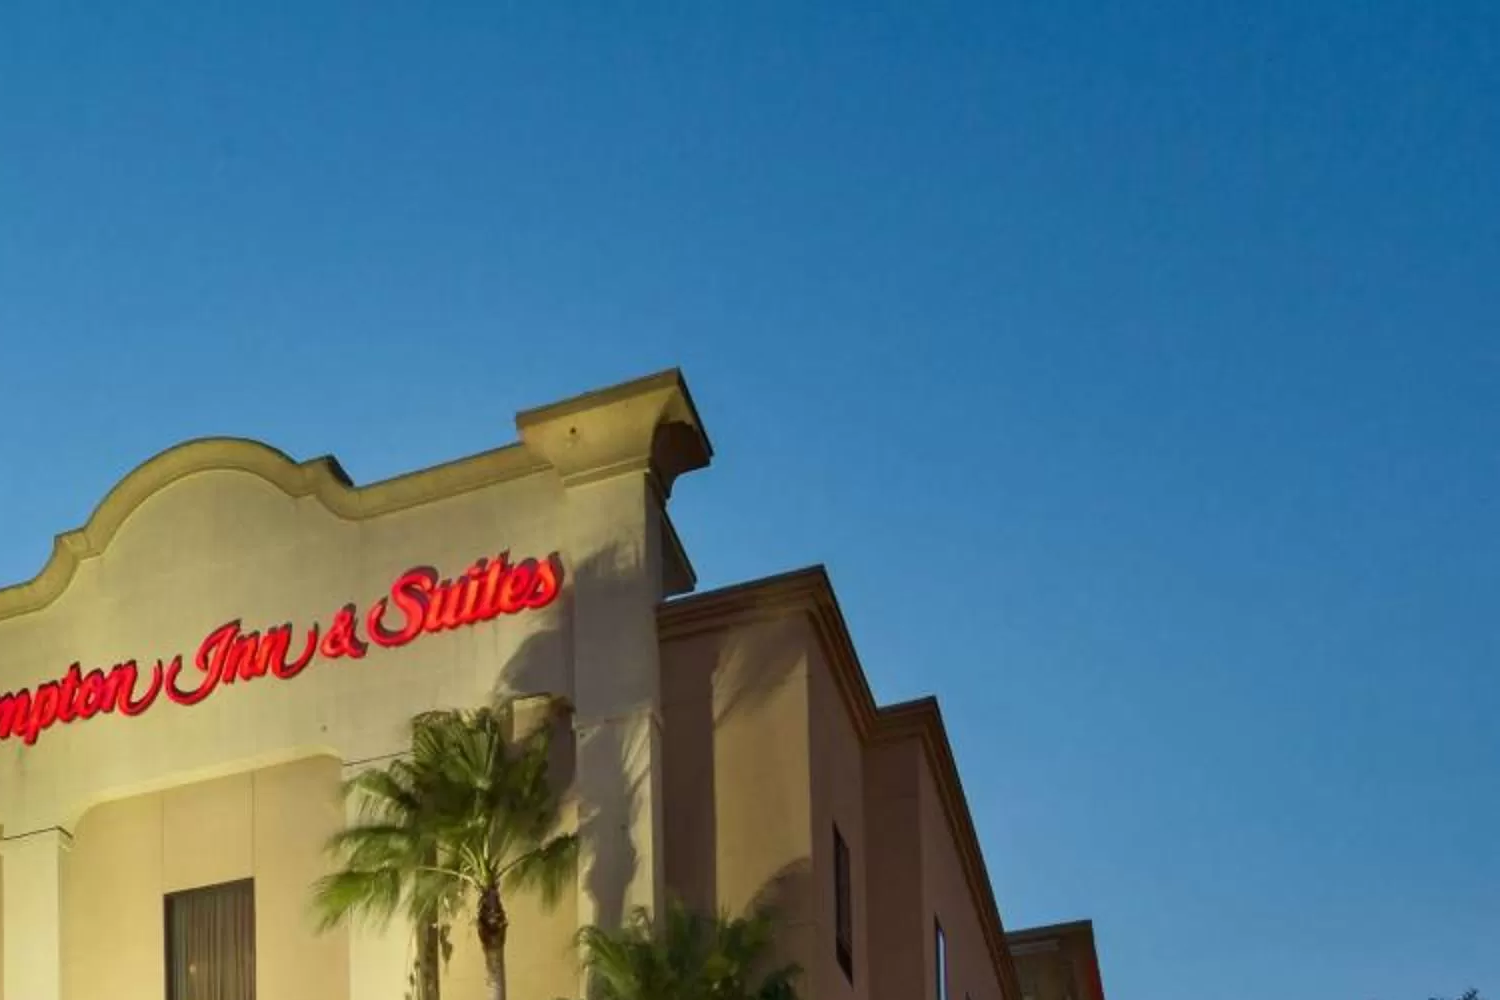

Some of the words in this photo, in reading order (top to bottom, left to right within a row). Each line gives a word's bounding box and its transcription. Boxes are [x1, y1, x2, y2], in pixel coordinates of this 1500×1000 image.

[164, 617, 319, 707] Inn
[319, 601, 368, 660] &
[364, 548, 565, 649] Suites
